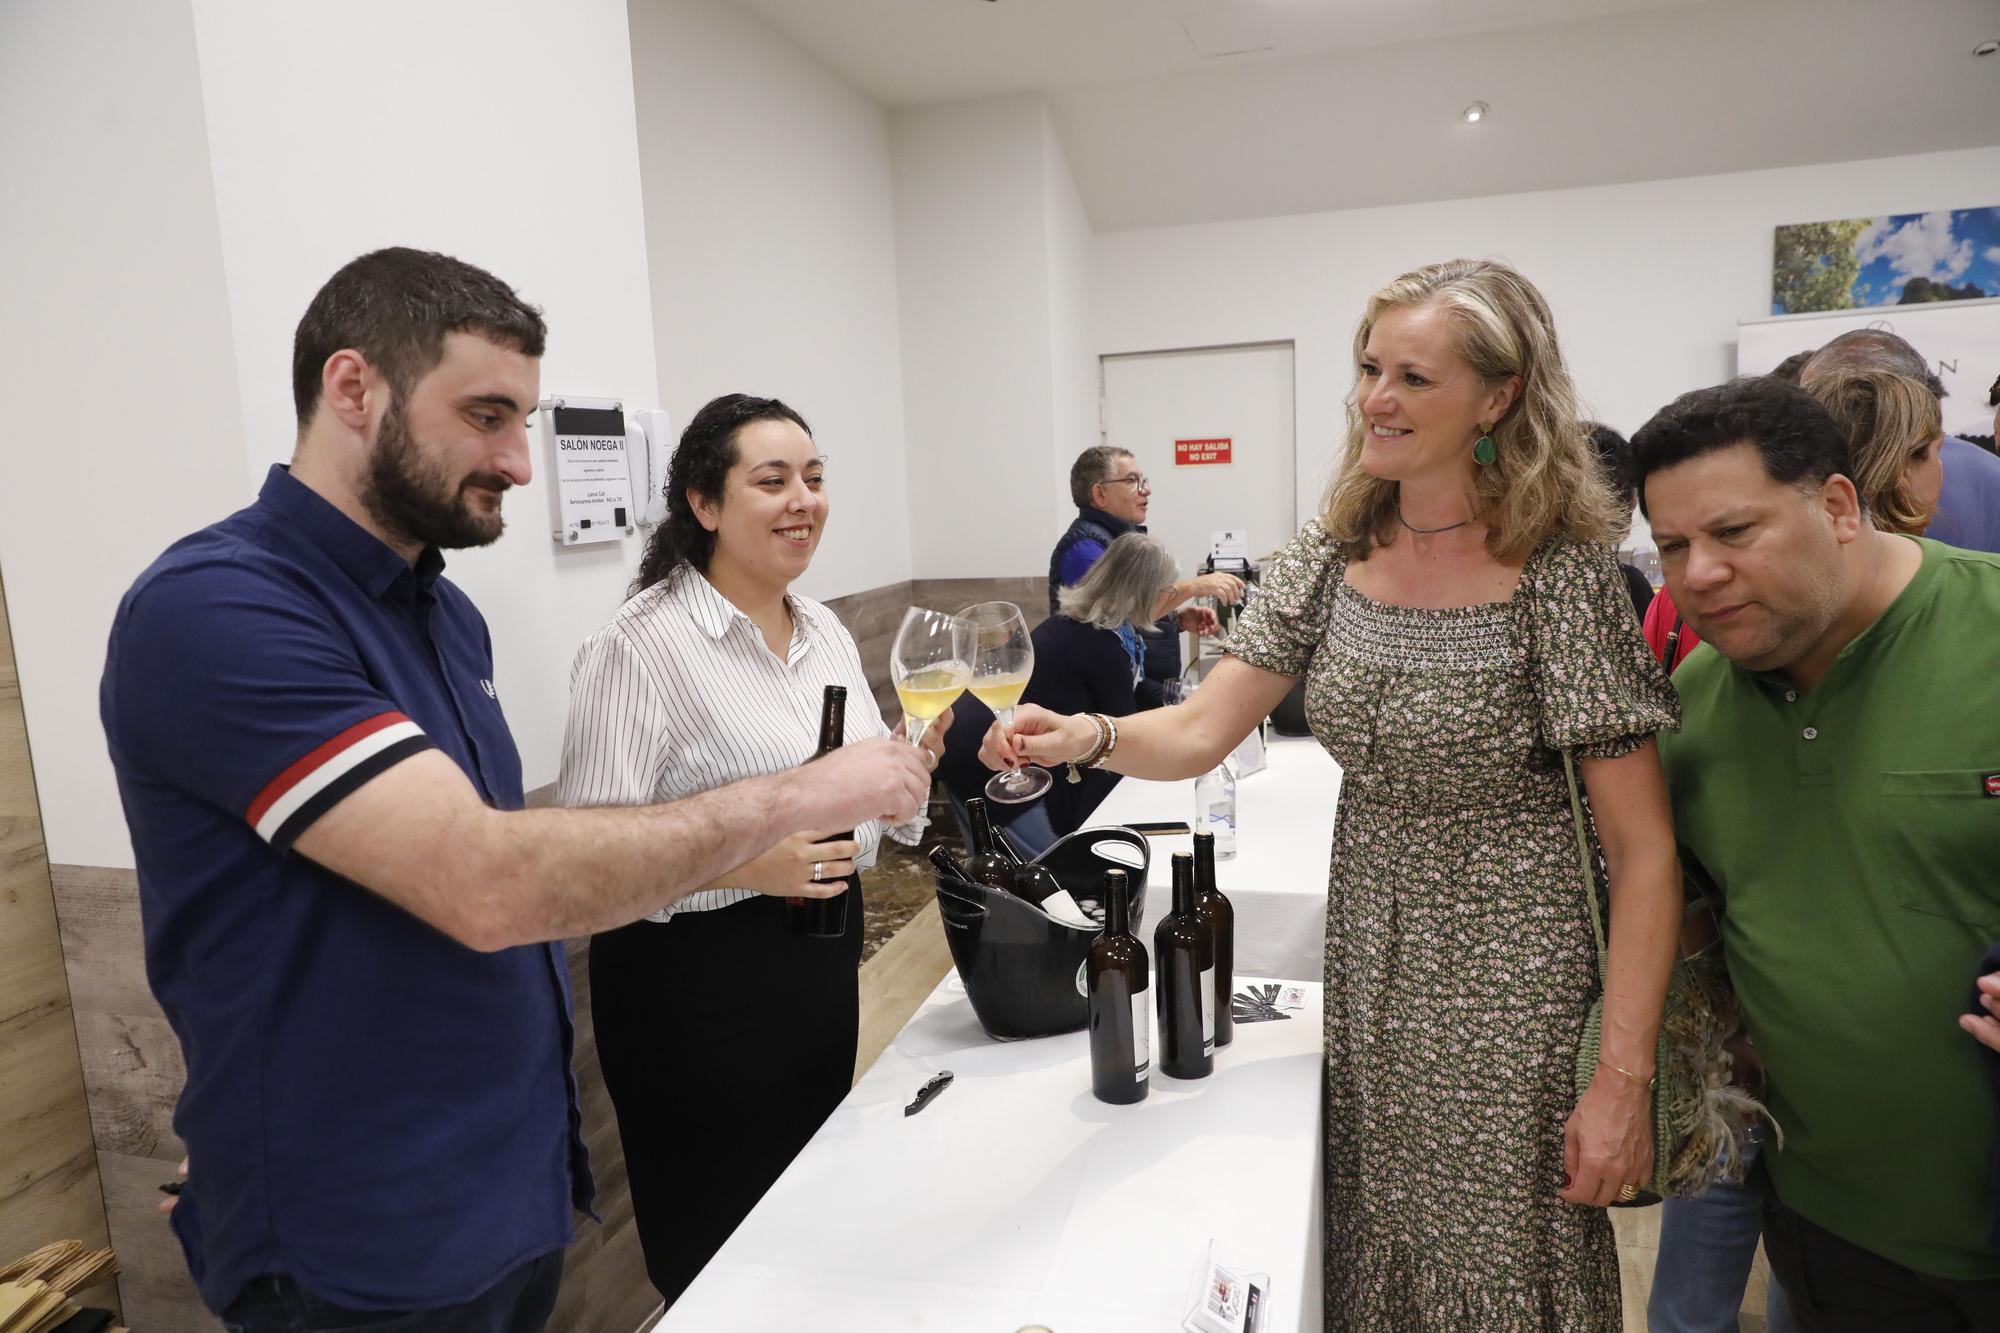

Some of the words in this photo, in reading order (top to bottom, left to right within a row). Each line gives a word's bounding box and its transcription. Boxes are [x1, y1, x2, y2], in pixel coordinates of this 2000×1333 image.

[560, 437, 588, 451] SALÓN
[590, 439, 618, 451] NOEGA
[1177, 444, 1188, 452] NO
[1189, 443, 1203, 451] HAY
[1204, 442, 1229, 451] SALIDA
[1189, 453, 1200, 461] NO
[1201, 452, 1217, 461] EXIT
